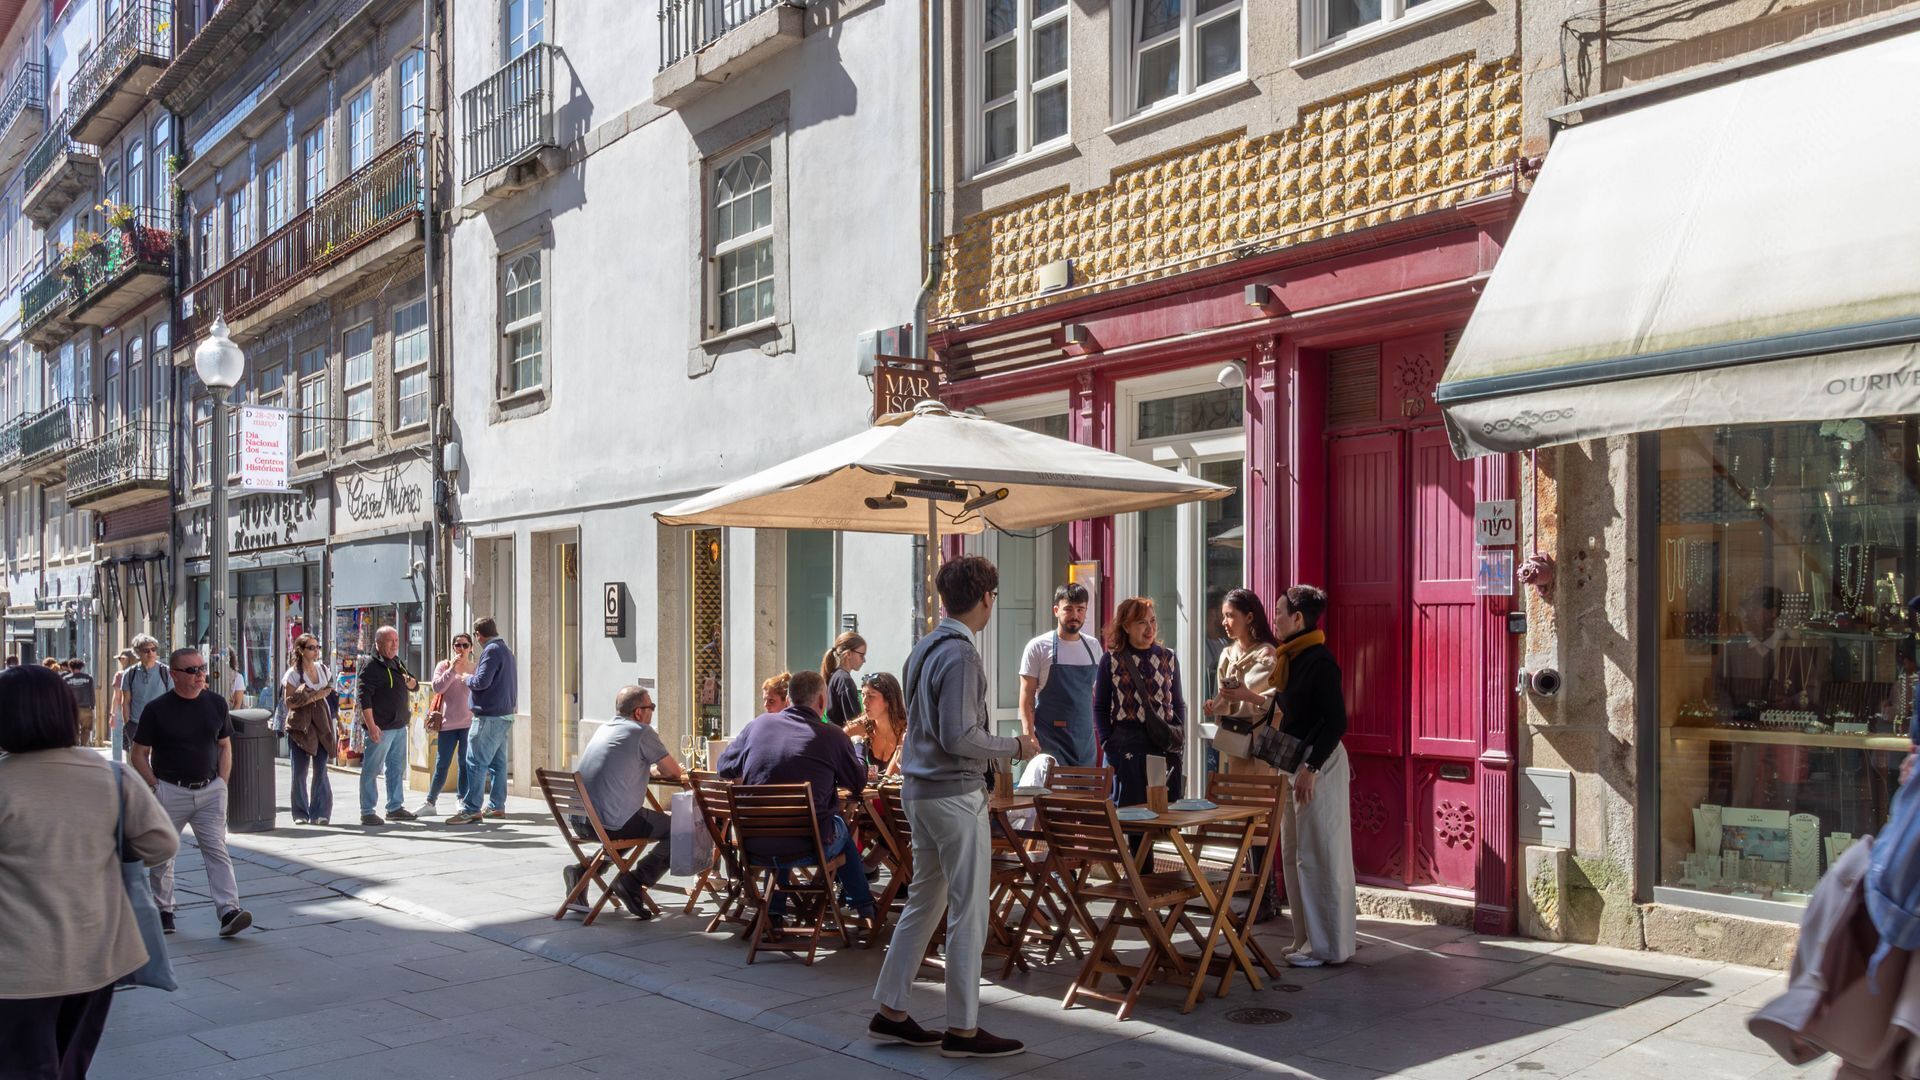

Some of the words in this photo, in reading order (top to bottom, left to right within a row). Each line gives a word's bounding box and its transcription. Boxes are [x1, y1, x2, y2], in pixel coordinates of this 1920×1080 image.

[885, 374, 931, 398] MAR
[1401, 397, 1425, 416] 179
[245, 410, 253, 418] D
[278, 413, 285, 421] N
[253, 420, 277, 428] março
[245, 431, 259, 439] Dia
[245, 439, 279, 448] Nacional
[245, 446, 260, 454] dos
[254, 457, 284, 466] Centros
[245, 463, 284, 473] Históricos
[256, 479, 274, 487] 2026
[606, 586, 617, 615] 6
